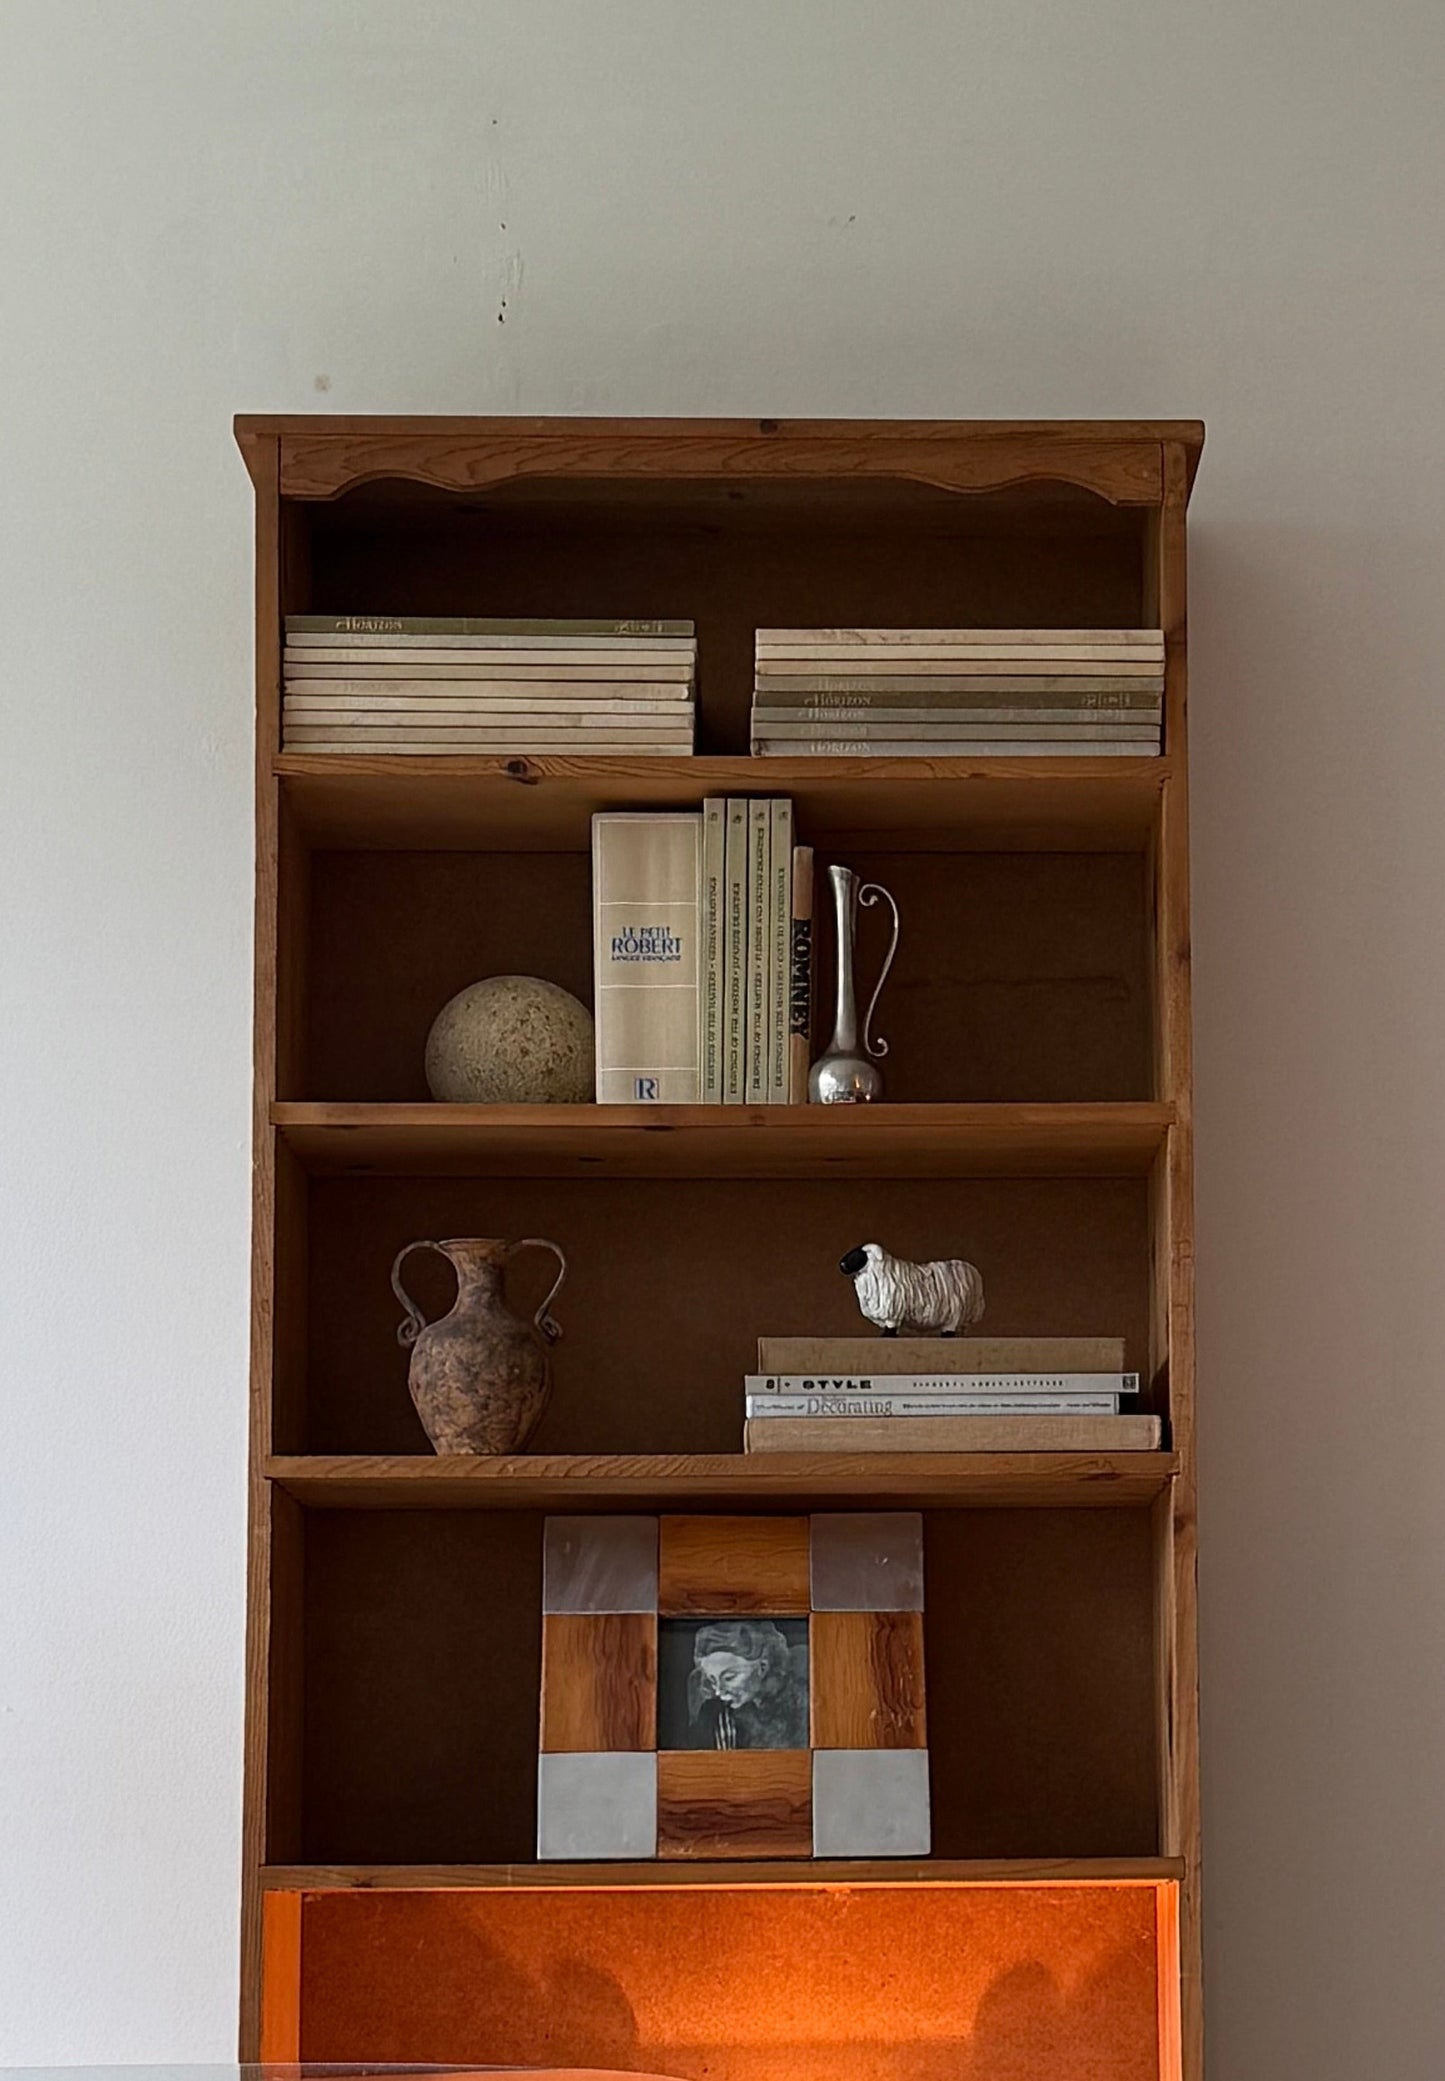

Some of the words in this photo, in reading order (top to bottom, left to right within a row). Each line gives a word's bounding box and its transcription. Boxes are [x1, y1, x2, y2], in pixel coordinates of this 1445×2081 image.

[622, 926, 635, 938] LE
[640, 926, 671, 938] PETIT
[611, 937, 683, 954] ROBERT
[790, 919, 811, 1040] ROMNEY
[708, 1031, 717, 1043] OF
[753, 1033, 762, 1043] OF
[775, 1030, 784, 1041] OF
[730, 1037, 739, 1048] OF
[638, 1079, 656, 1099] R
[802, 1379, 872, 1390] STYLE
[807, 1397, 893, 1417] Decorating
